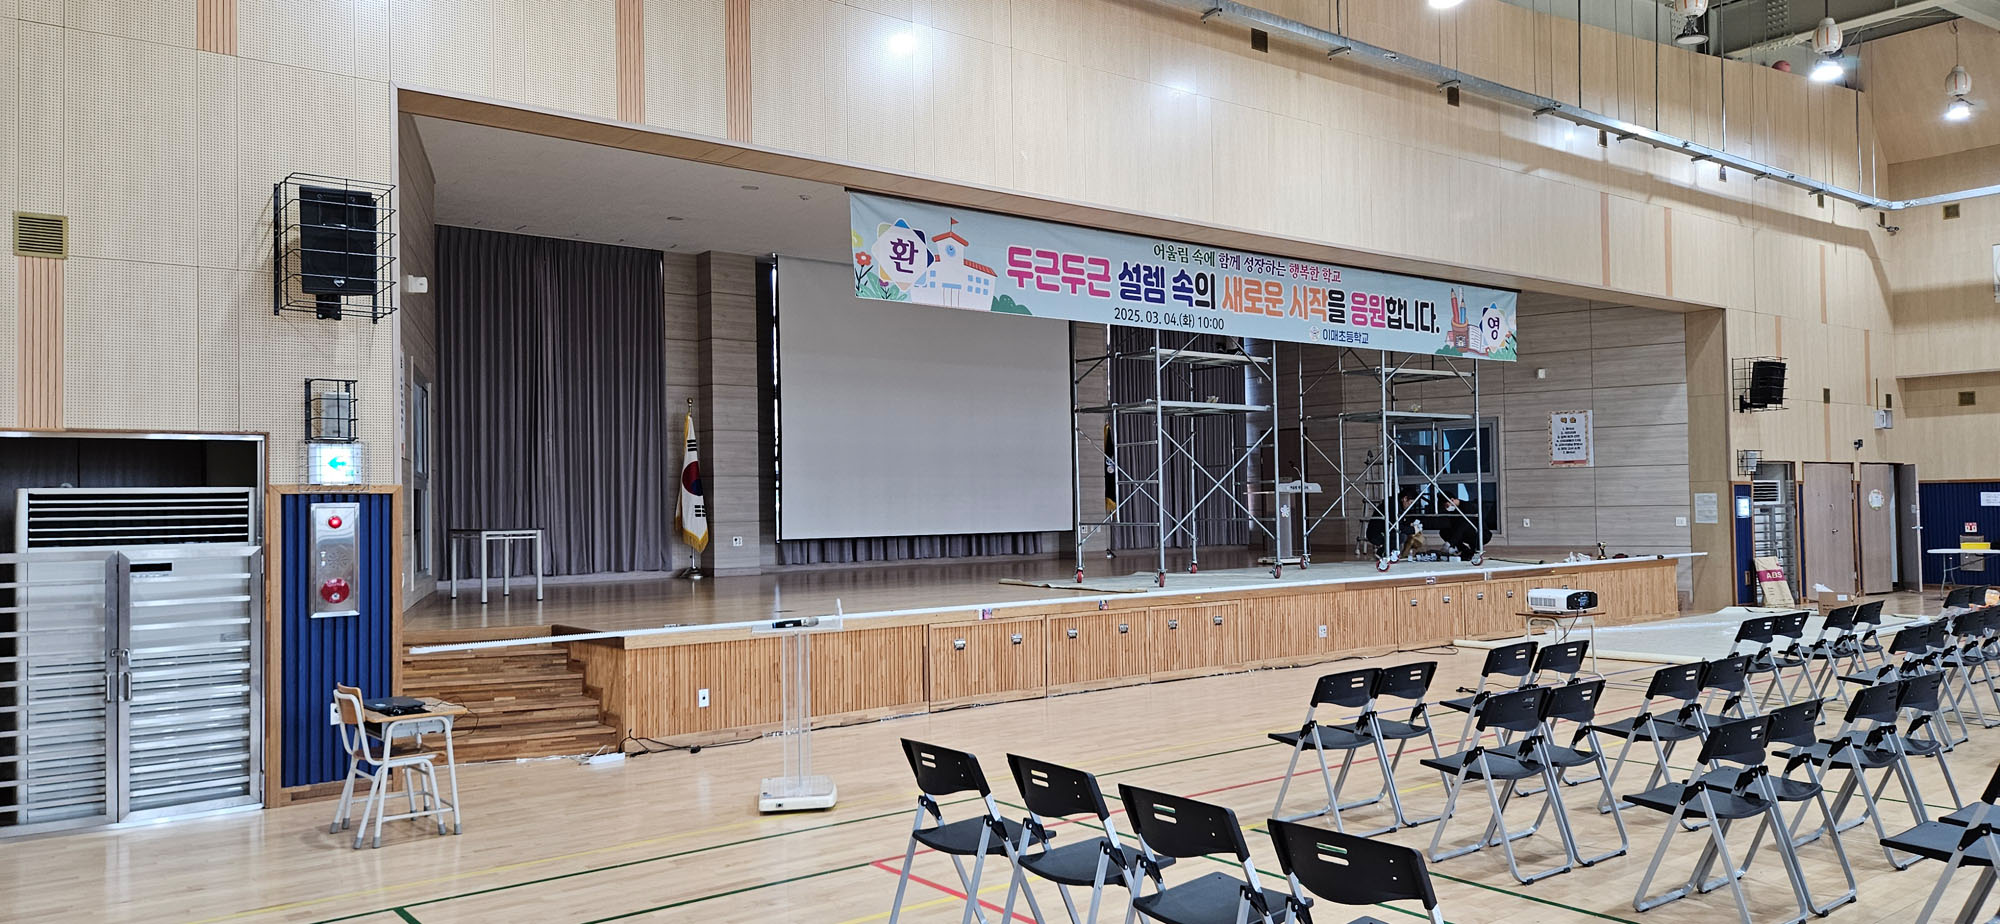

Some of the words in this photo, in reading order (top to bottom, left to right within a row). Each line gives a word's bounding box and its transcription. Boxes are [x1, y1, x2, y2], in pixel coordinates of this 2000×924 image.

[889, 238, 919, 274] 환
[1153, 244, 1188, 263] 어울림
[1191, 249, 1216, 267] 속에
[1218, 253, 1241, 270] 함께
[1243, 258, 1286, 276] 성장하는
[1289, 263, 1319, 281] 행복한
[1322, 267, 1342, 283] 학교
[1007, 246, 1112, 298] 두근두근
[1118, 261, 1166, 305] 설렘
[1171, 268, 1217, 310] 속의
[1221, 275, 1285, 317] 새로운
[1288, 284, 1347, 325] 시작을
[1351, 292, 1440, 333] 응원합니다.
[1114, 308, 1143, 323] 2025.
[1145, 311, 1162, 325] 03.
[1198, 316, 1224, 330] 10:00
[1487, 316, 1500, 341] 영
[1322, 328, 1369, 344] 이매초등학교
